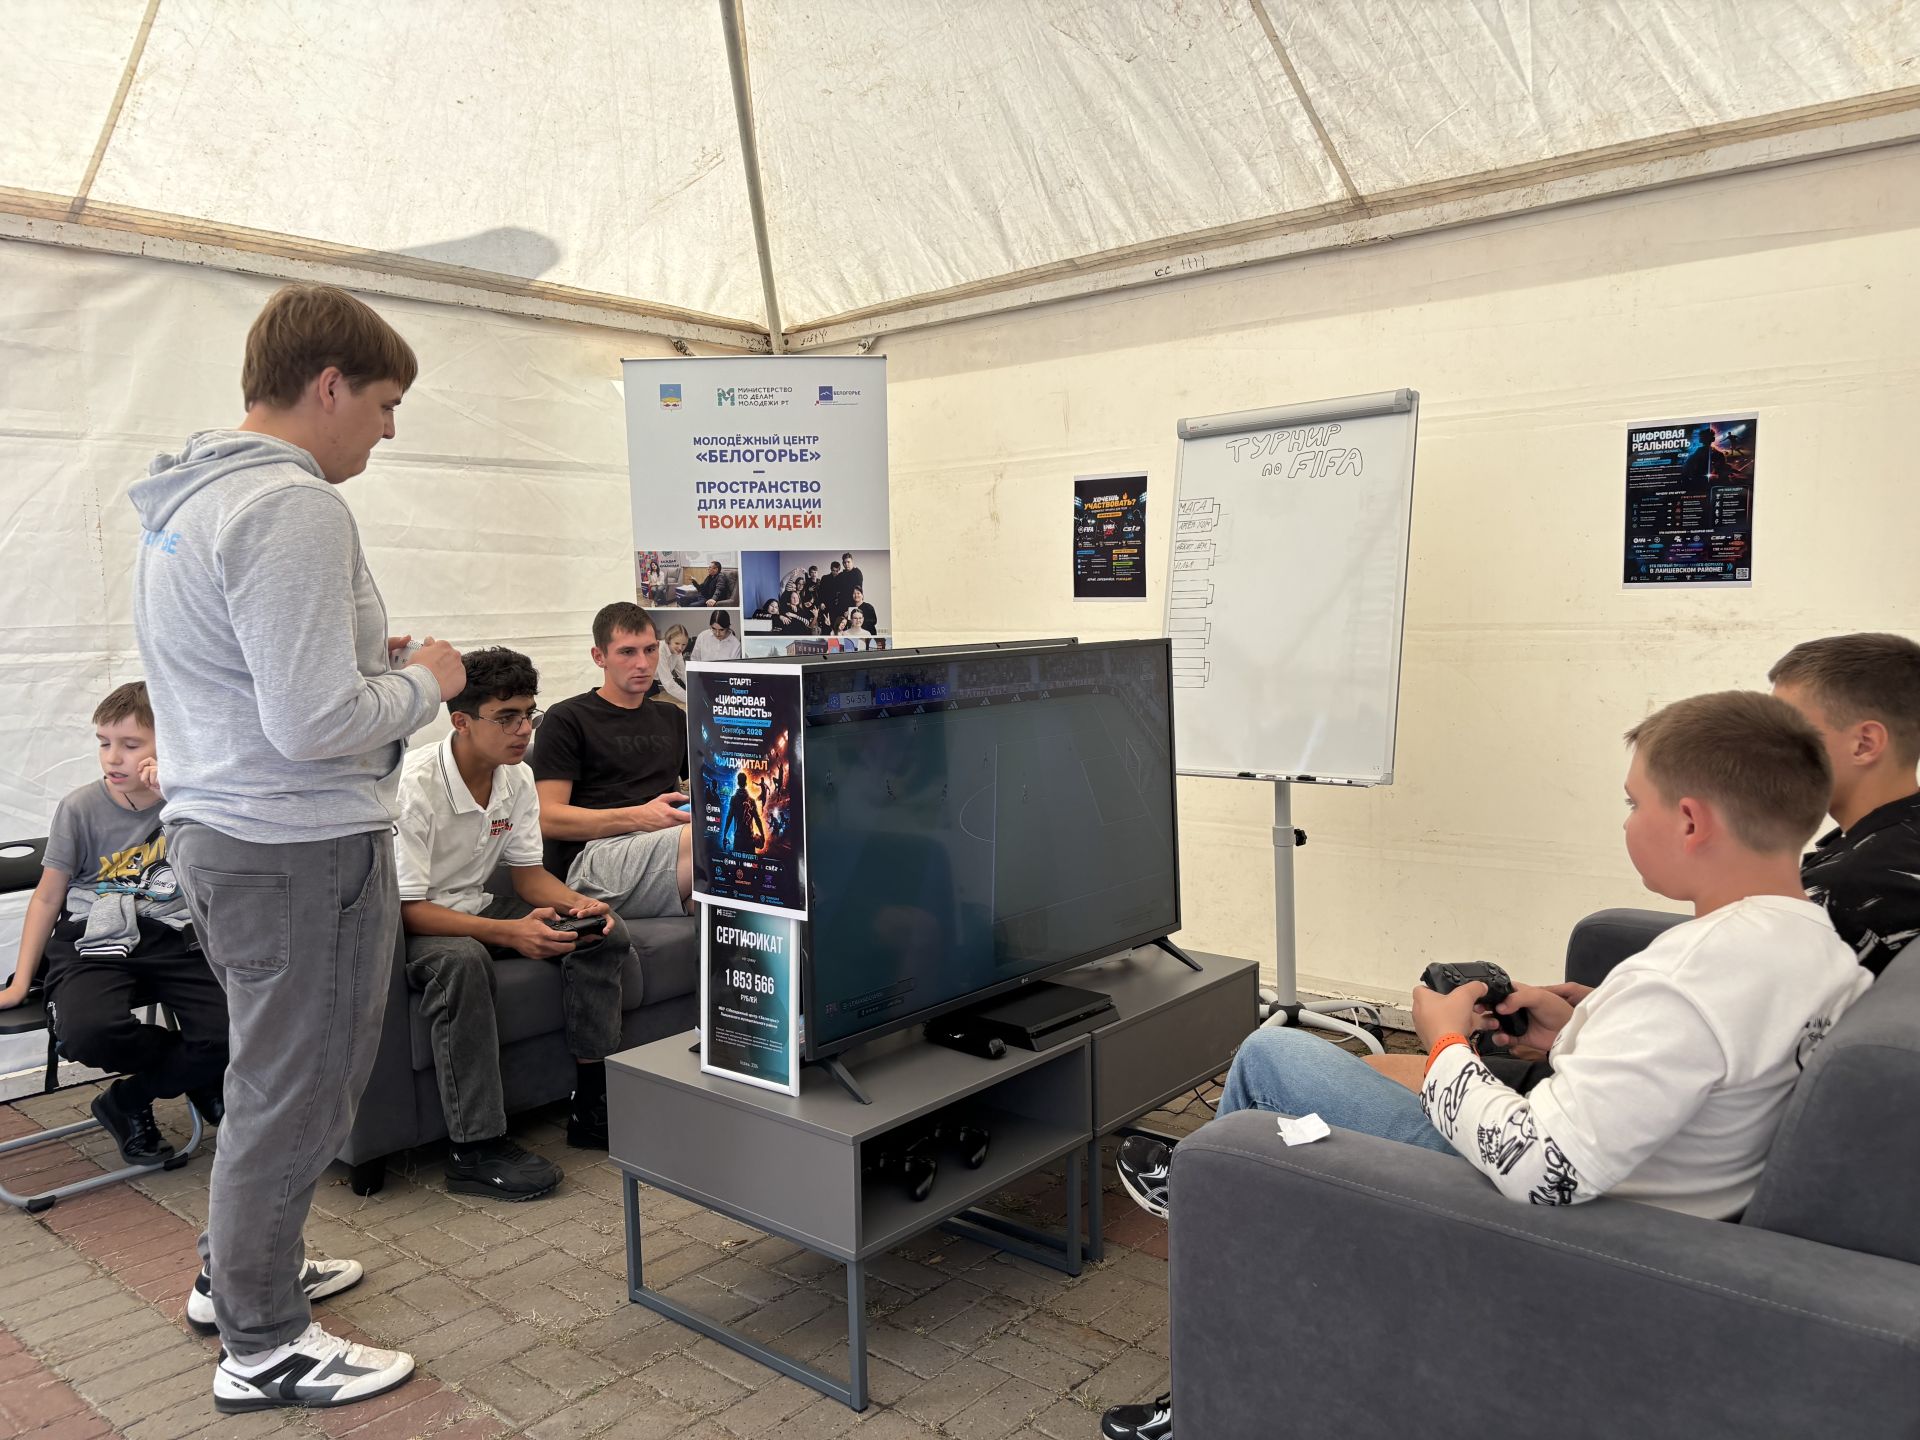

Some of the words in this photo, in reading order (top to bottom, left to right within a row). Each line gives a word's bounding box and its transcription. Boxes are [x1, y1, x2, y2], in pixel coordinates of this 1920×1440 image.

[737, 386, 793, 394] МИНИСТЕРСТВО
[750, 393, 774, 401] ДЕЛАМ
[738, 400, 778, 408] МОЛОДЕЖИ
[693, 434, 780, 447] МОЛОДЁЖНЫЙ
[783, 435, 819, 447] ЦЕНТР
[1632, 429, 1685, 443] ЦИФРОВАЯ
[1225, 423, 1342, 463] ТУРНИР
[1632, 439, 1691, 452] РЕАЛЬНОСТЬ
[695, 449, 822, 463] «БЕЛОГОРЬЕ»
[1288, 447, 1363, 478] FIFA
[696, 480, 821, 494] ПРОСТРАНСТВО
[697, 500, 727, 511] ДЛЯ
[730, 498, 822, 510] РЕАЛИЗАЦИИ
[1084, 499, 1136, 510] УЧАСТВОВАТЬ?
[1092, 494, 1119, 503] ХОЧЕШЬ
[698, 514, 759, 529] ТВОИХ
[764, 511, 822, 531] ИДЕЙ!
[729, 677, 752, 686] СТАРТ!
[715, 694, 766, 707] «ЦИФРОВАЯ
[880, 691, 895, 702] OLY
[931, 686, 947, 697] BAR
[713, 705, 772, 718] РЕАЛЬНОСТЬ»
[715, 756, 768, 770] ФИДЖИТАЛ
[716, 925, 783, 954] СЕРТИФИКАТ
[725, 968, 730, 986] 1
[733, 969, 752, 990] 853
[754, 974, 775, 995] 566
[740, 994, 758, 1004] РУБЛЕЙ
